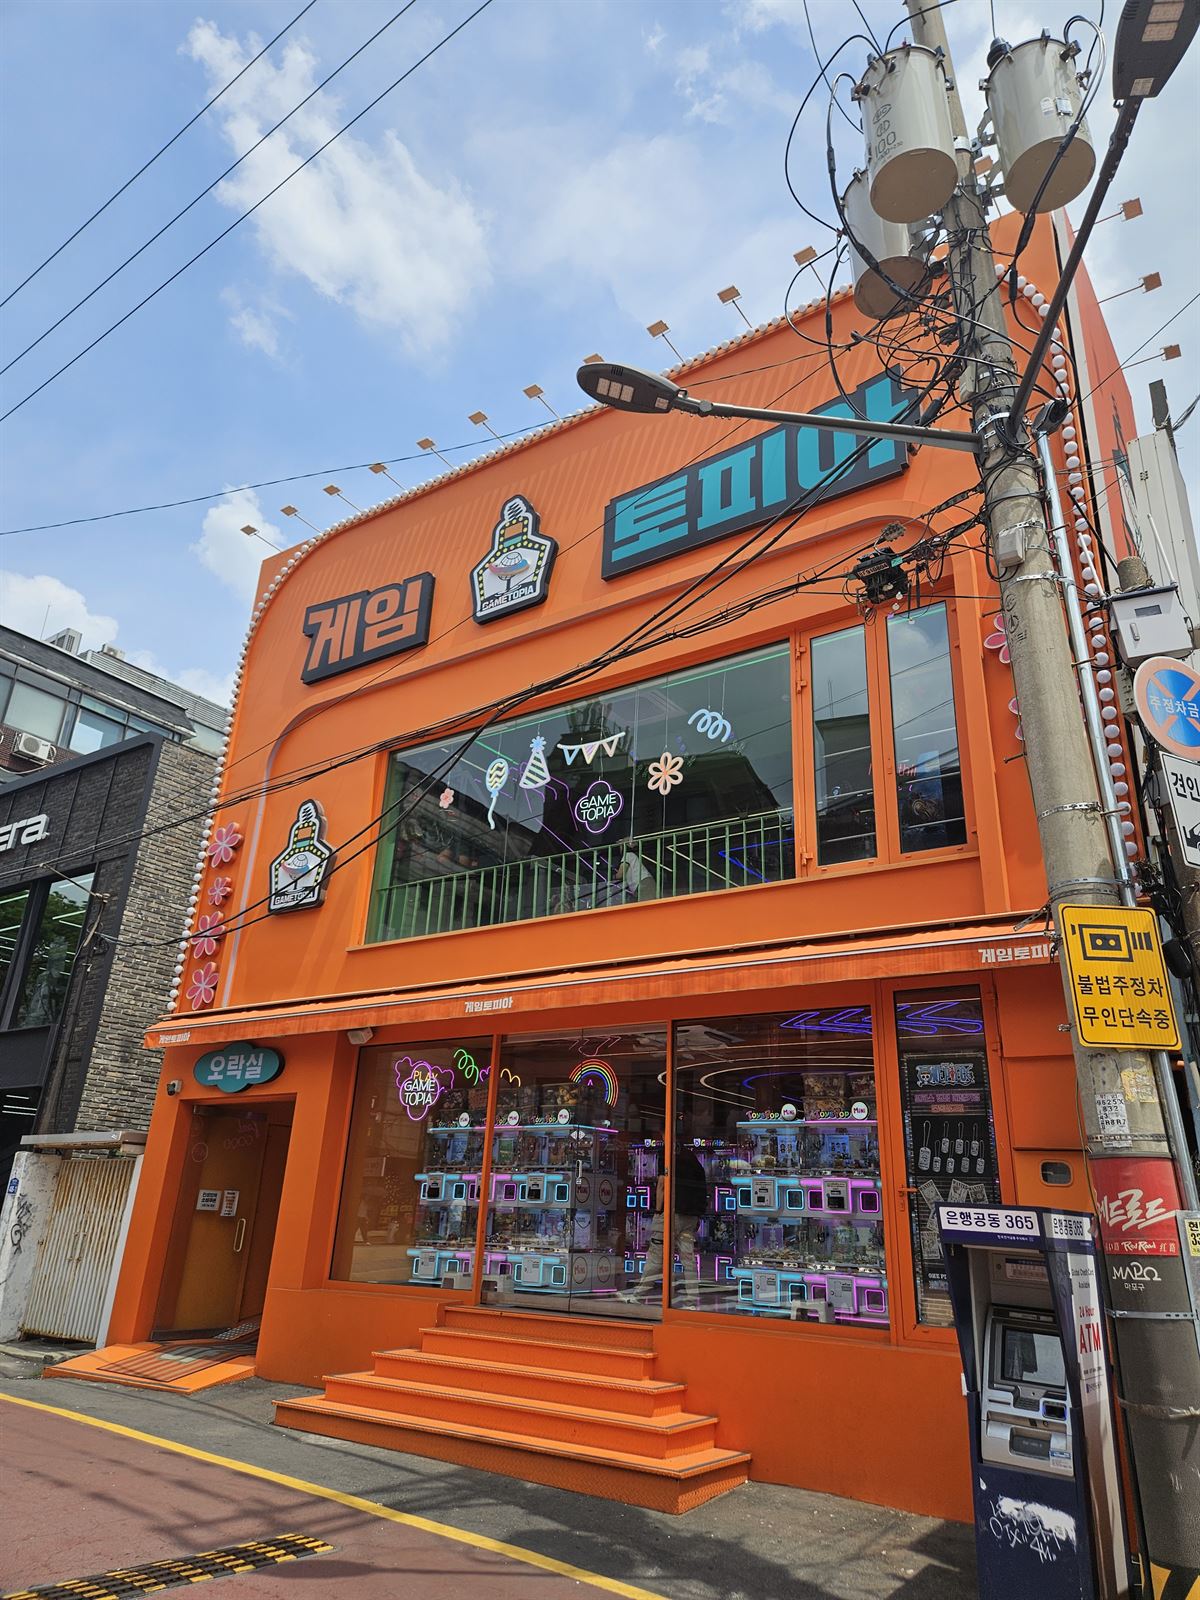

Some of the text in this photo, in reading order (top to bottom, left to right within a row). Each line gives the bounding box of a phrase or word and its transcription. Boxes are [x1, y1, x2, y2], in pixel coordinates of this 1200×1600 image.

[612, 378, 909, 562] 토피아
[482, 585, 534, 611] GAMETOPIA
[307, 579, 423, 671] 게임
[1149, 695, 1200, 718] 주정차금
[1170, 771, 1200, 801] 견인
[580, 793, 617, 809] GAME
[580, 806, 615, 821] TOPIA
[1077, 974, 1164, 998] 불법주정차
[464, 996, 513, 1013] 게임토피아
[1082, 1006, 1170, 1030] 무인단속중
[207, 1052, 264, 1081] 오락실
[404, 1079, 435, 1092] GAME
[405, 1092, 432, 1106] TOPIA
[946, 1210, 1034, 1230] 은행공동 365
[1138, 1241, 1156, 1253] Road
[1124, 1283, 1145, 1291] 마포구
[1080, 1322, 1101, 1354] ATM
